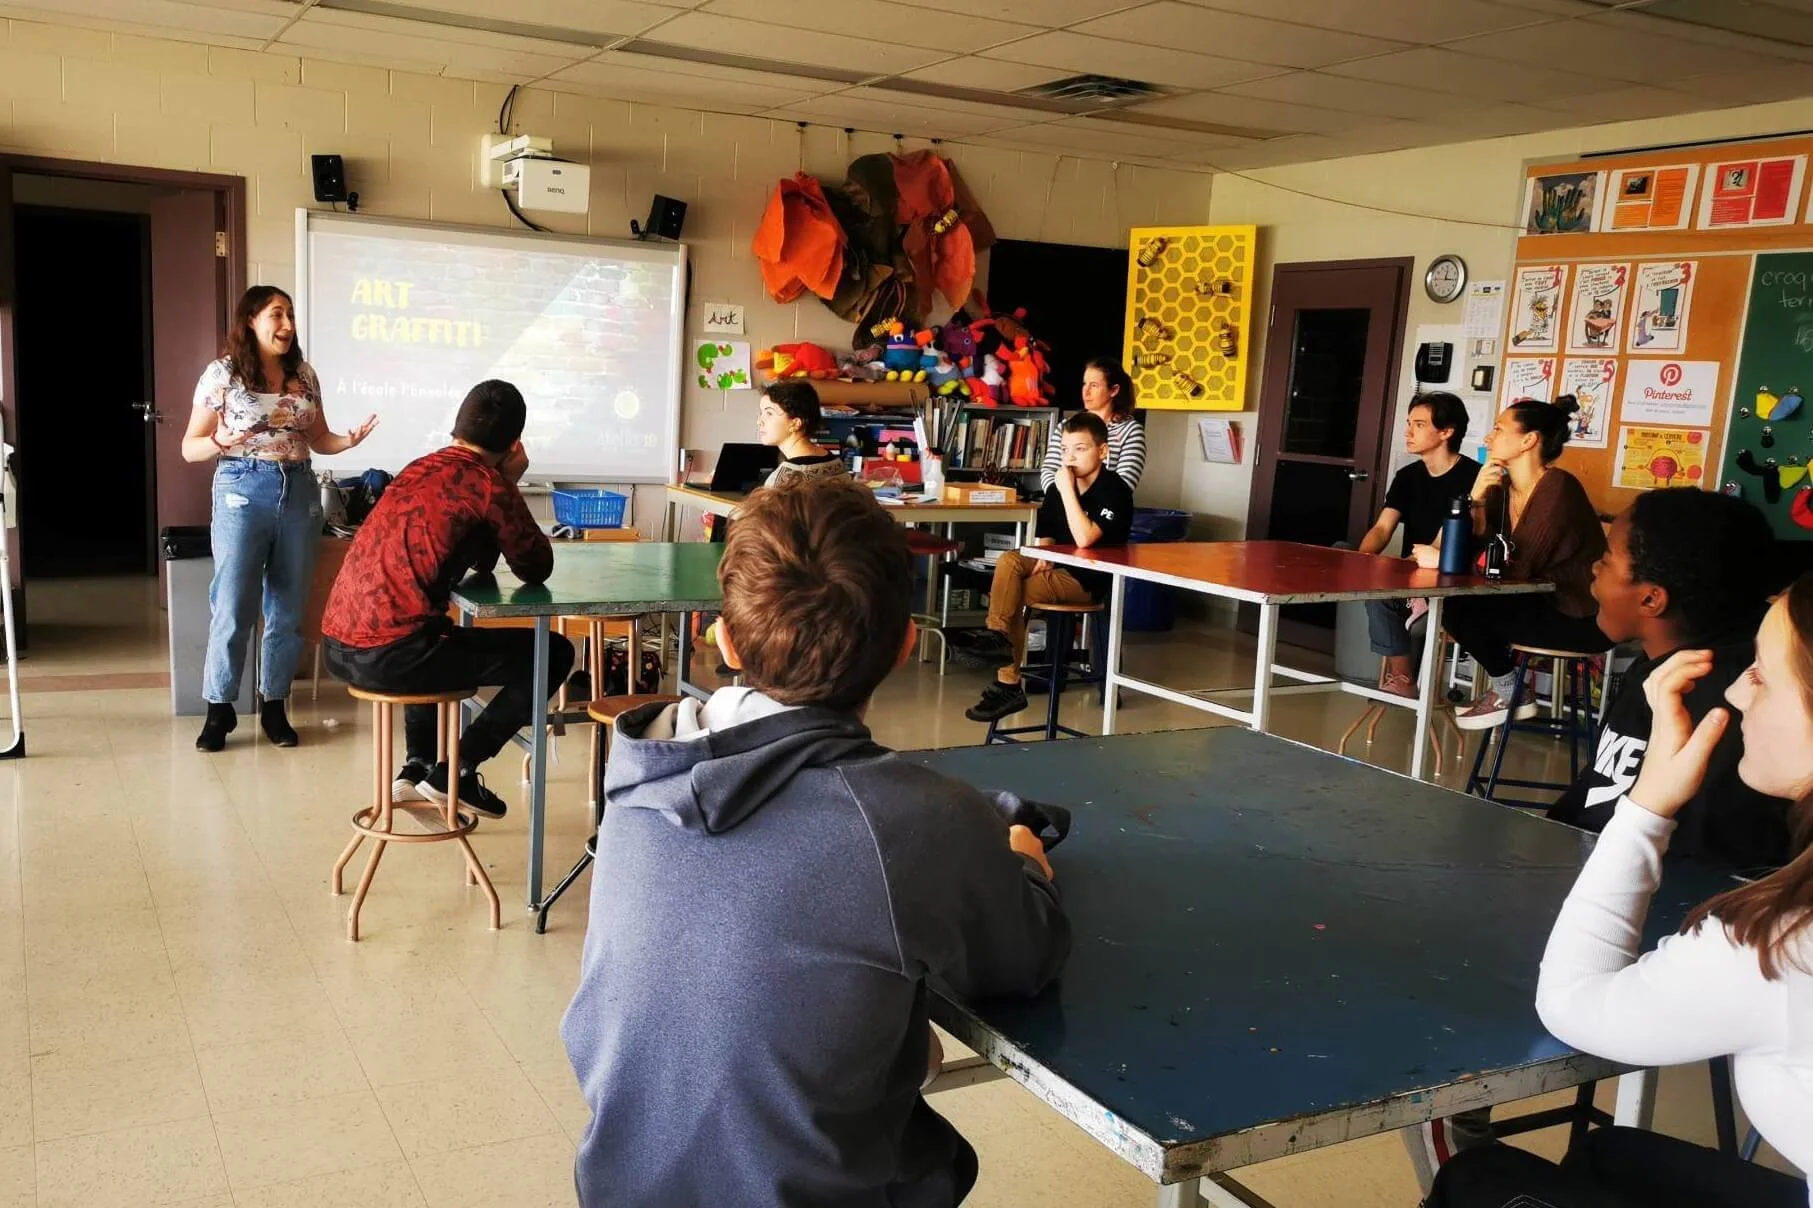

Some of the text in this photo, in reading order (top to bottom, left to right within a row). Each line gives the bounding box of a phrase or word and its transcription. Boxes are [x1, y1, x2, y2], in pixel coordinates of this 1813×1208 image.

[1761, 271, 1813, 292] croq
[352, 280, 414, 309] ART
[352, 314, 483, 348] GRAFFITI
[1643, 386, 1693, 401] Pinterest
